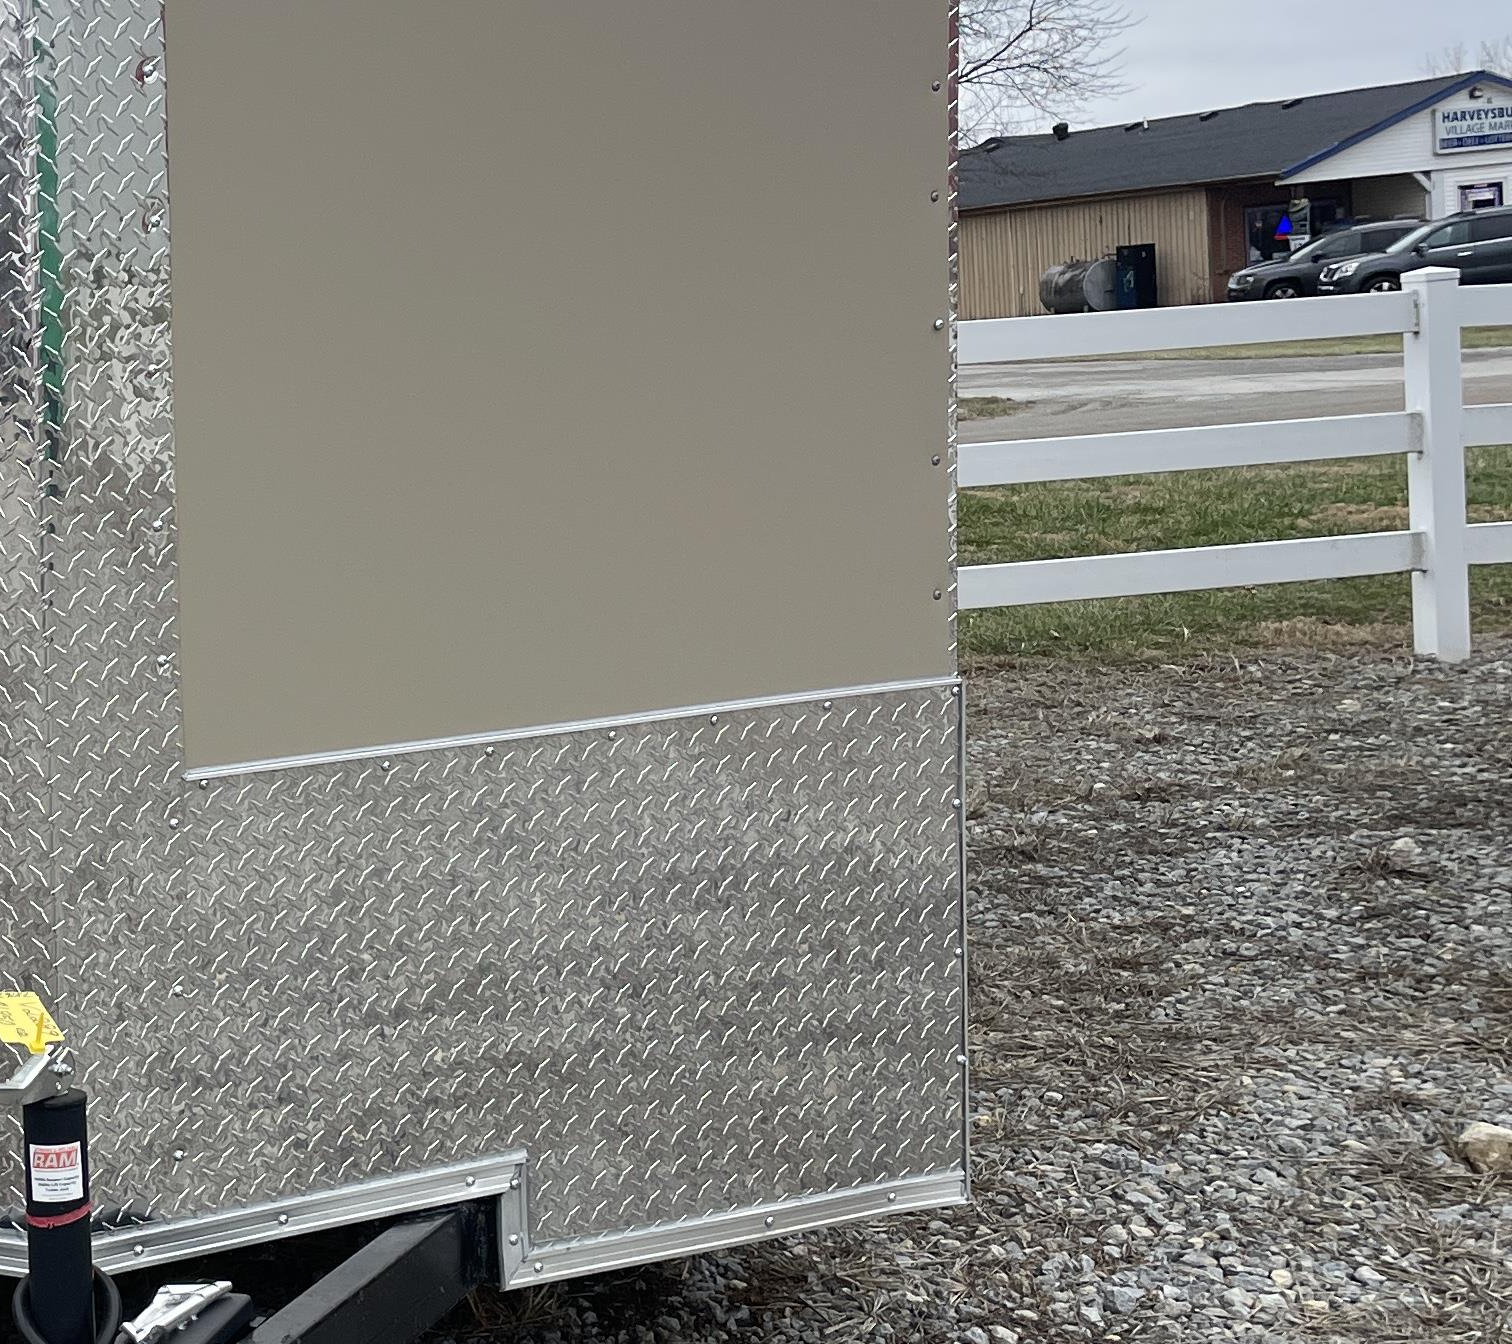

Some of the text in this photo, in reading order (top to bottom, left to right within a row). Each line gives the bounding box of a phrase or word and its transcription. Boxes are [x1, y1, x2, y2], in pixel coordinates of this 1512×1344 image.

[1445, 119, 1512, 136] VILLAGE MAR
[33, 1150, 76, 1167] RAM
